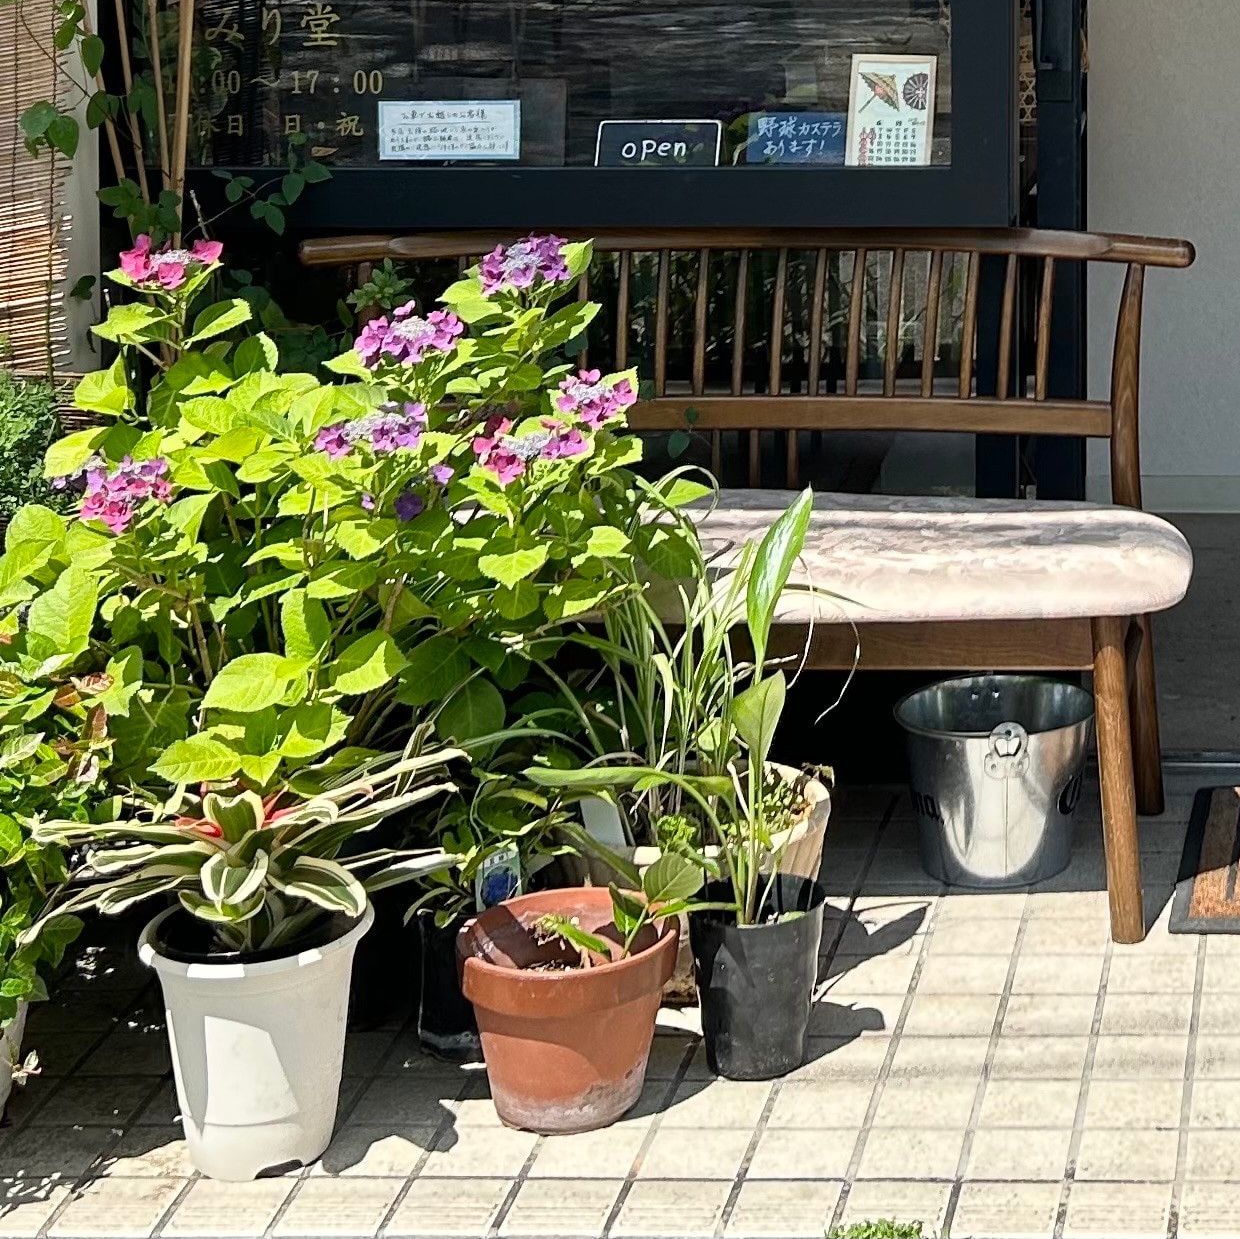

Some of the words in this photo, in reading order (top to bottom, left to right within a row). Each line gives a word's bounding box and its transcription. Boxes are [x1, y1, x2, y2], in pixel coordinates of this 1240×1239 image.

[757, 116, 843, 139] 野球カステラ
[621, 139, 687, 160] open
